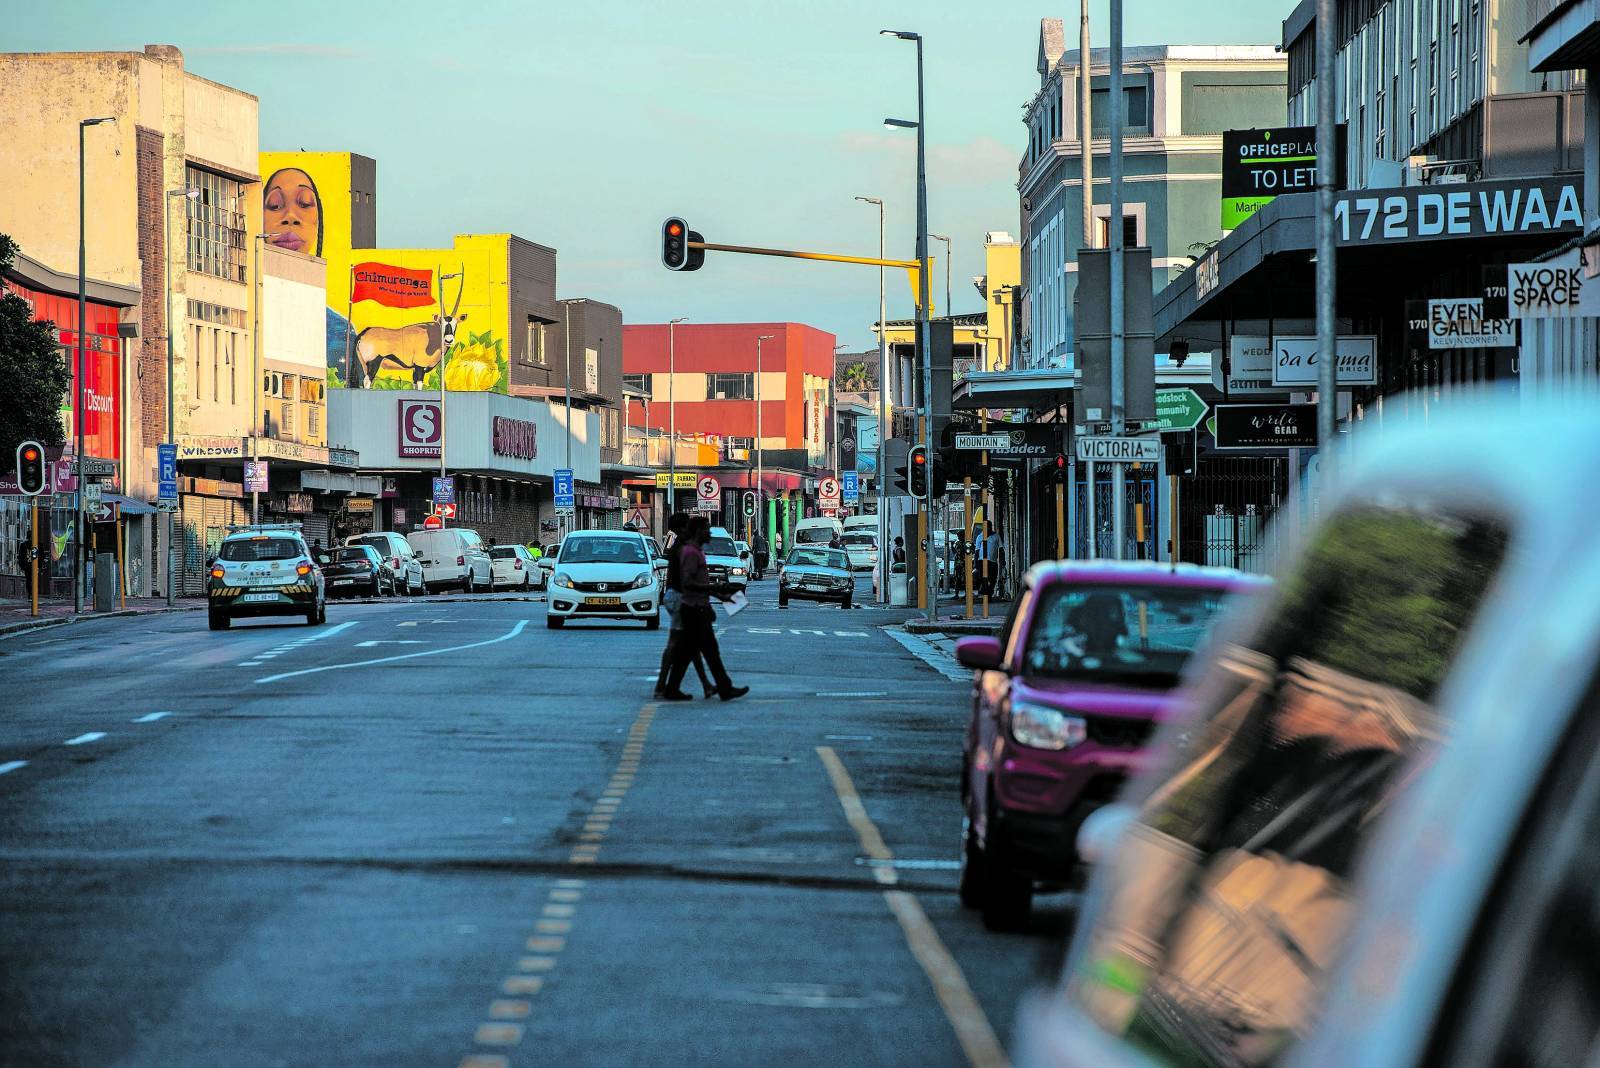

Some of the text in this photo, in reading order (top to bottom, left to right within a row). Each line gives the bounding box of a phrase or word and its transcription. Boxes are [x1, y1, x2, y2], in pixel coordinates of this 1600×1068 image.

[1251, 167, 1318, 188] TO LET
[1334, 196, 1409, 241] 172
[1418, 192, 1471, 236] DE
[355, 271, 428, 288] Chimurenga
[1514, 268, 1582, 287] WORK
[1485, 286, 1581, 306] 170 SPACE
[1432, 303, 1484, 320] EVEN
[1409, 319, 1514, 336] 170 GALLERY
[1433, 336, 1498, 346] KELVIN CORNER
[1242, 348, 1272, 356] WEDD
[1279, 349, 1300, 367] da
[87, 388, 114, 413] Discount
[1274, 426, 1298, 435] GEAR
[960, 436, 998, 447] MOUNTAIN
[1083, 441, 1144, 457] VICTORIA
[182, 446, 239, 456] WINDOWS
[71, 464, 106, 474] ARDEEN
[163, 463, 173, 480] R
[558, 482, 568, 494] R
